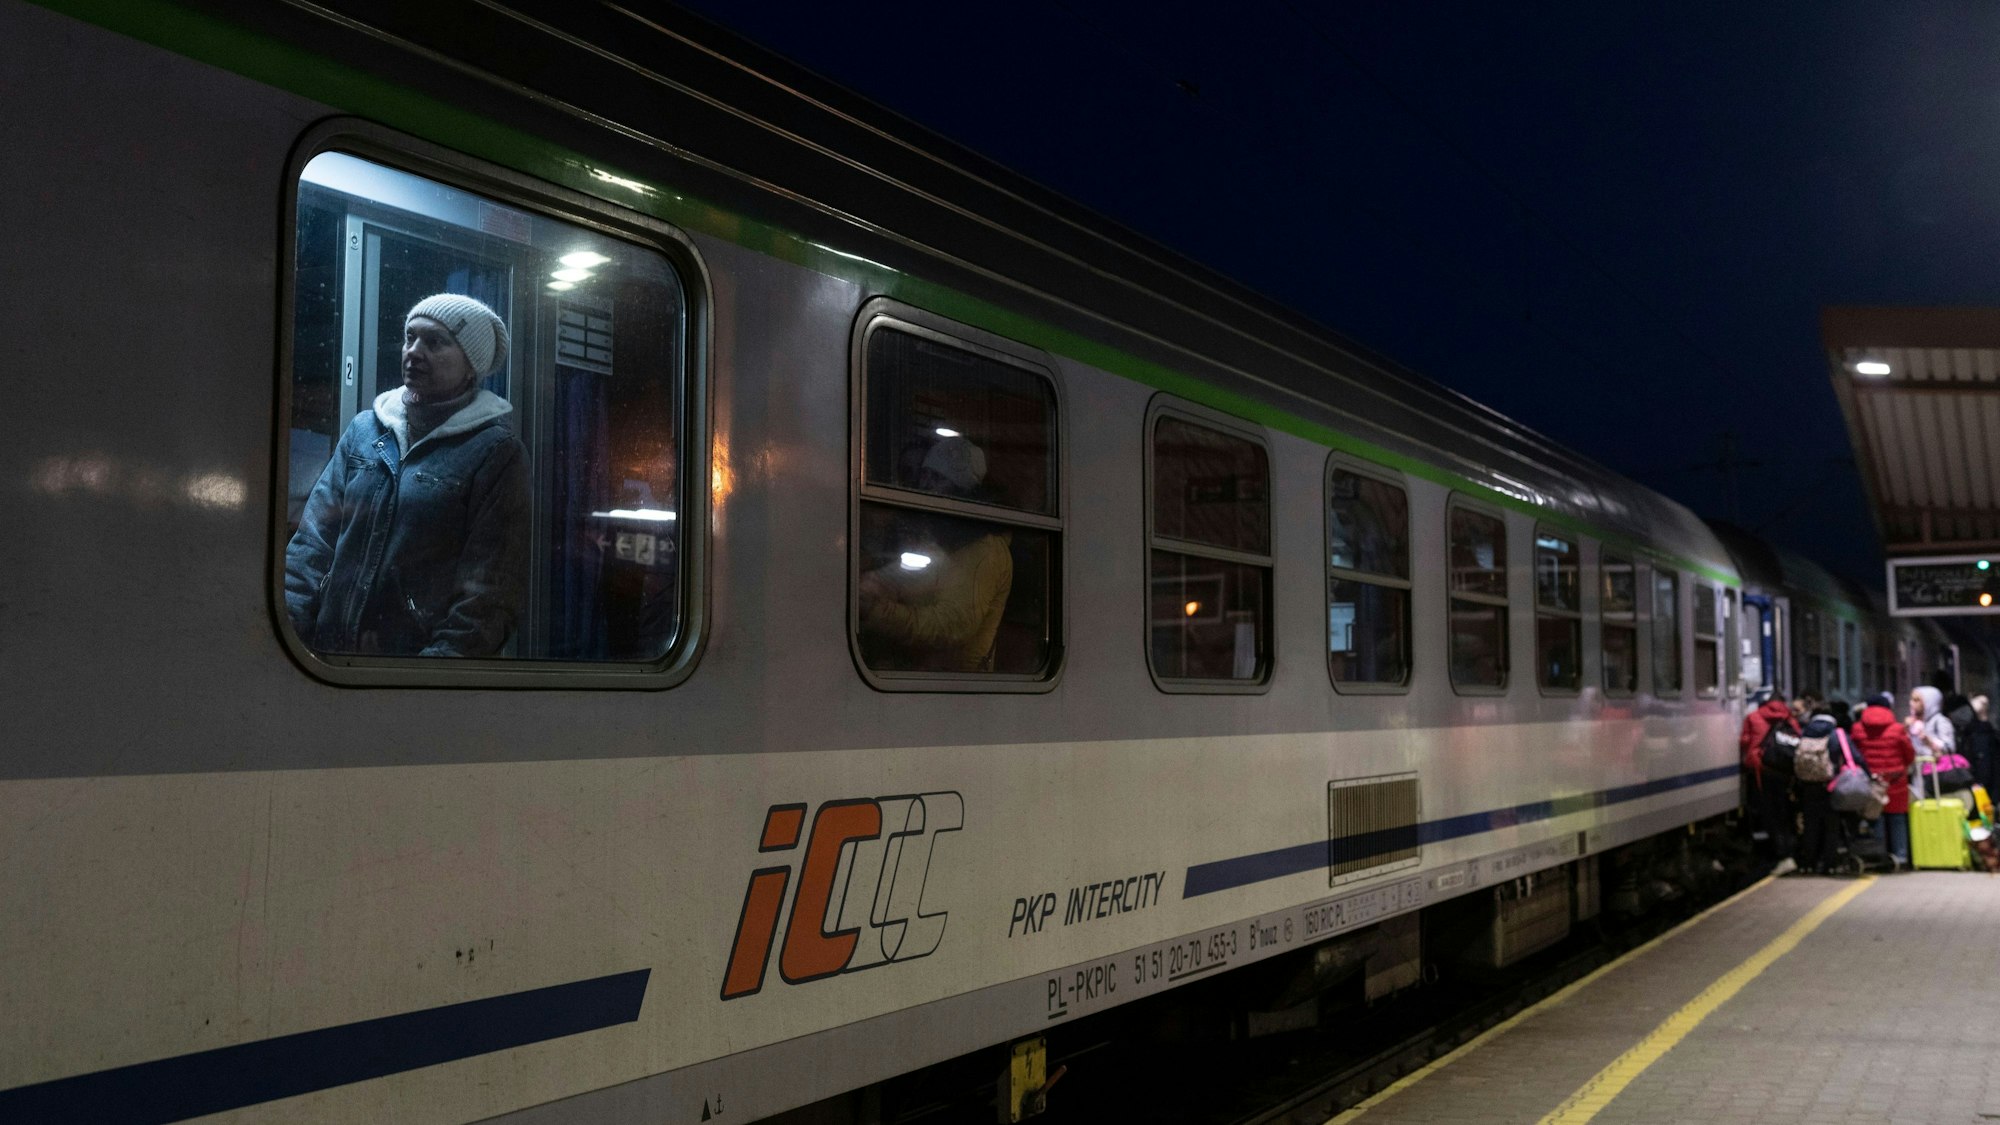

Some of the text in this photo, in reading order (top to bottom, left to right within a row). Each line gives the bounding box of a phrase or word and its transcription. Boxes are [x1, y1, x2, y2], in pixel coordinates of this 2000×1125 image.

[347, 362, 352, 380] 2
[1009, 871, 1166, 938] PKP INTERCITY
[1047, 962, 1117, 1012] PL-PKPIC
[1135, 955, 1146, 985] 51
[1152, 950, 1163, 980] 51
[1169, 939, 1202, 975] 20-70
[1207, 930, 1238, 963] 455-3
